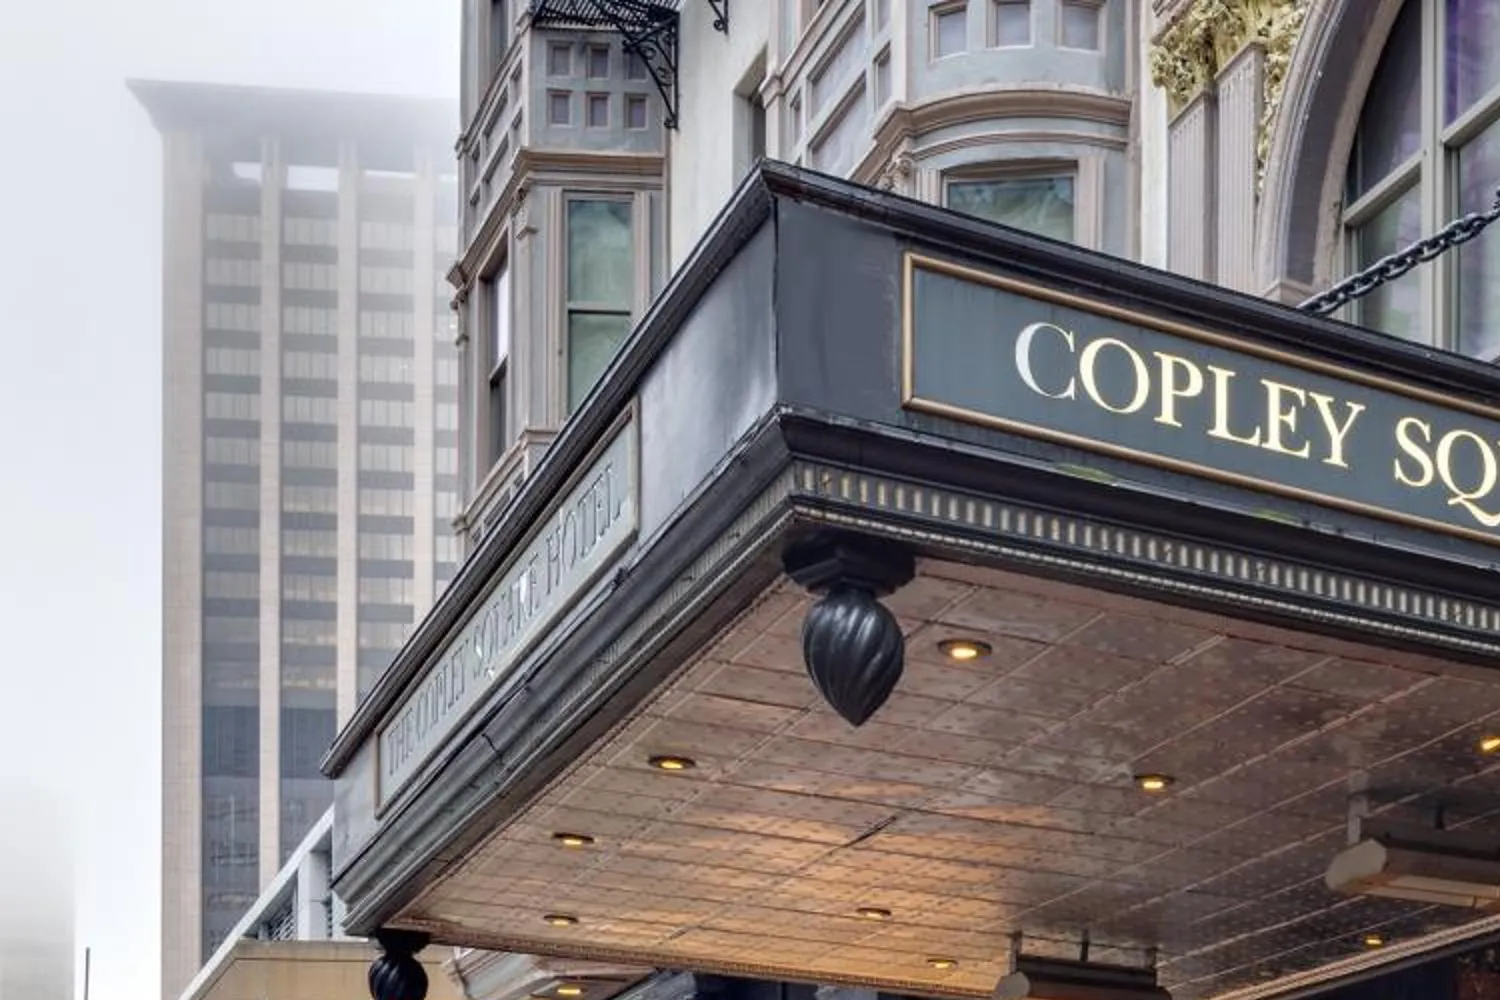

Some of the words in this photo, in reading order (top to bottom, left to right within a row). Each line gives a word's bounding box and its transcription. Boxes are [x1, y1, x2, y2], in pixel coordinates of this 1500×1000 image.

[1015, 321, 1366, 470] COPLEY
[473, 551, 539, 679] SQUARE
[545, 461, 622, 595] HOTEL
